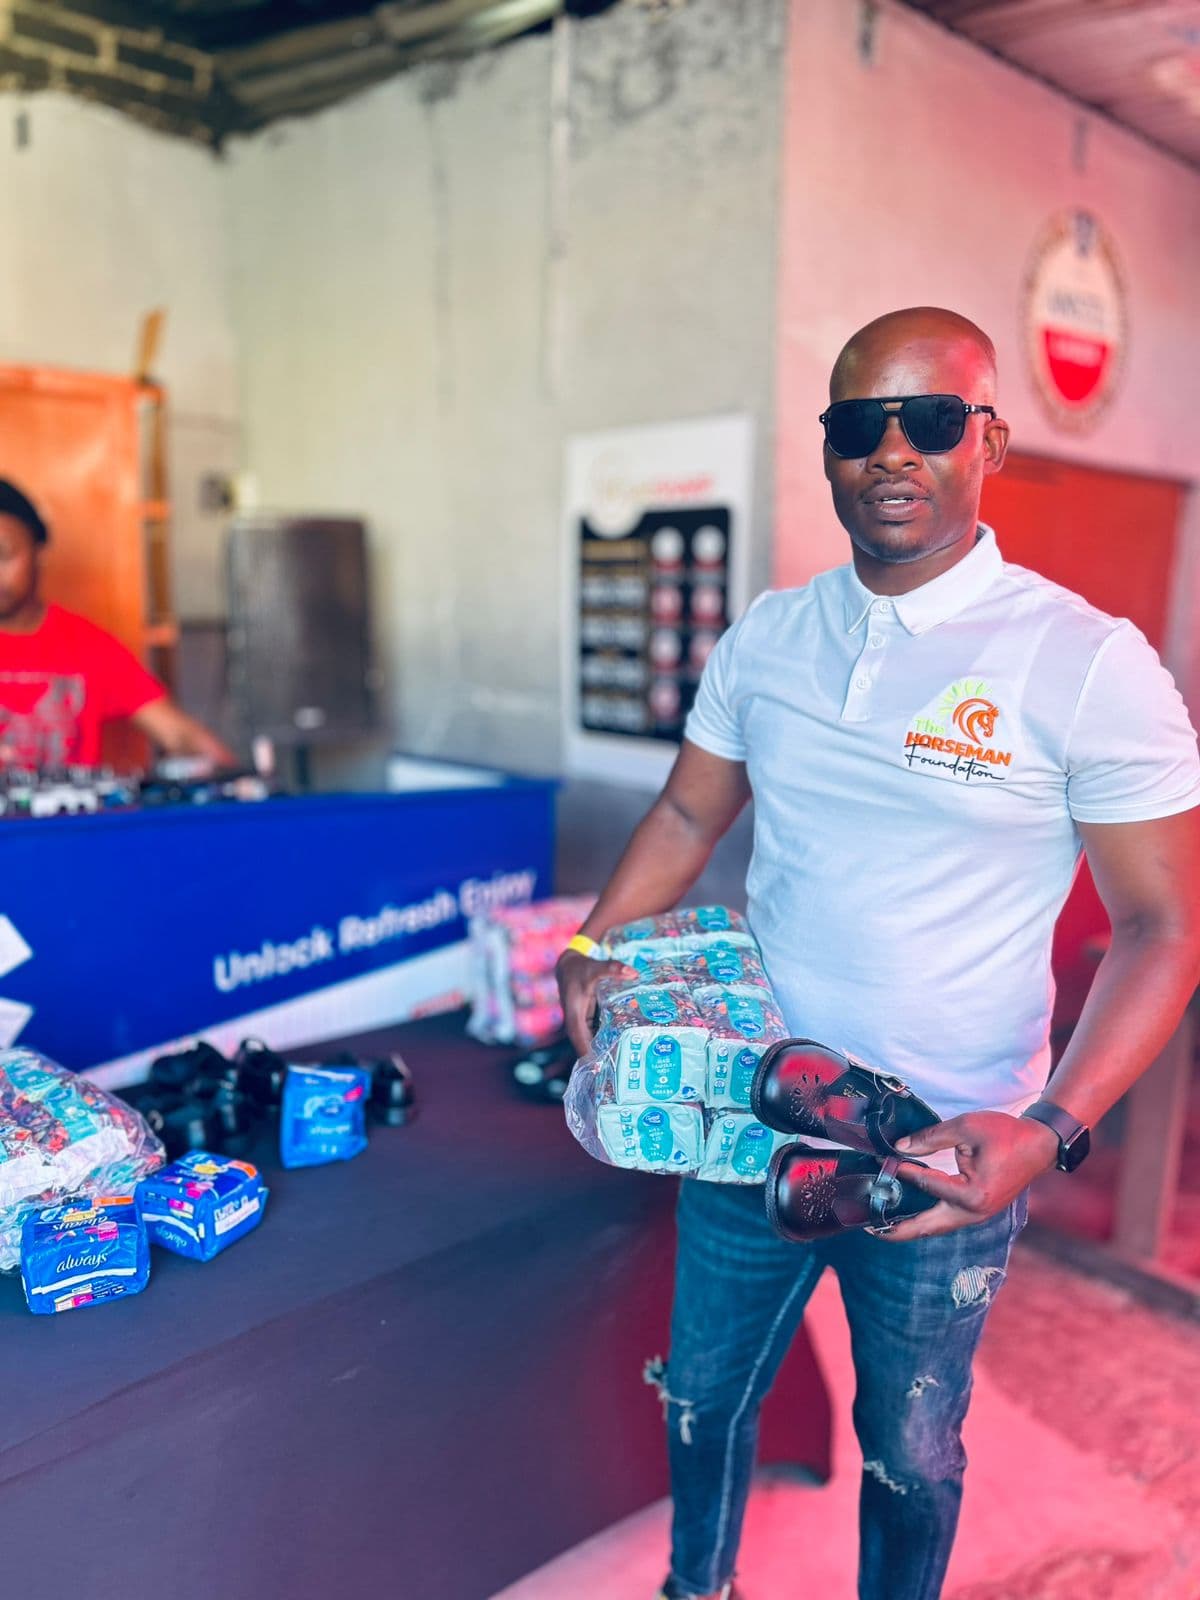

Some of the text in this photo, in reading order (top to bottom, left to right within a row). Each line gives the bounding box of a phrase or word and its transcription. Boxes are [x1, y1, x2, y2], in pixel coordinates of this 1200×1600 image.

[904, 743, 1005, 781] Foundation
[905, 731, 1012, 767] HORSEMAN
[214, 924, 334, 993] Unlock
[337, 887, 457, 954] Refresh
[56, 1253, 109, 1273] always
